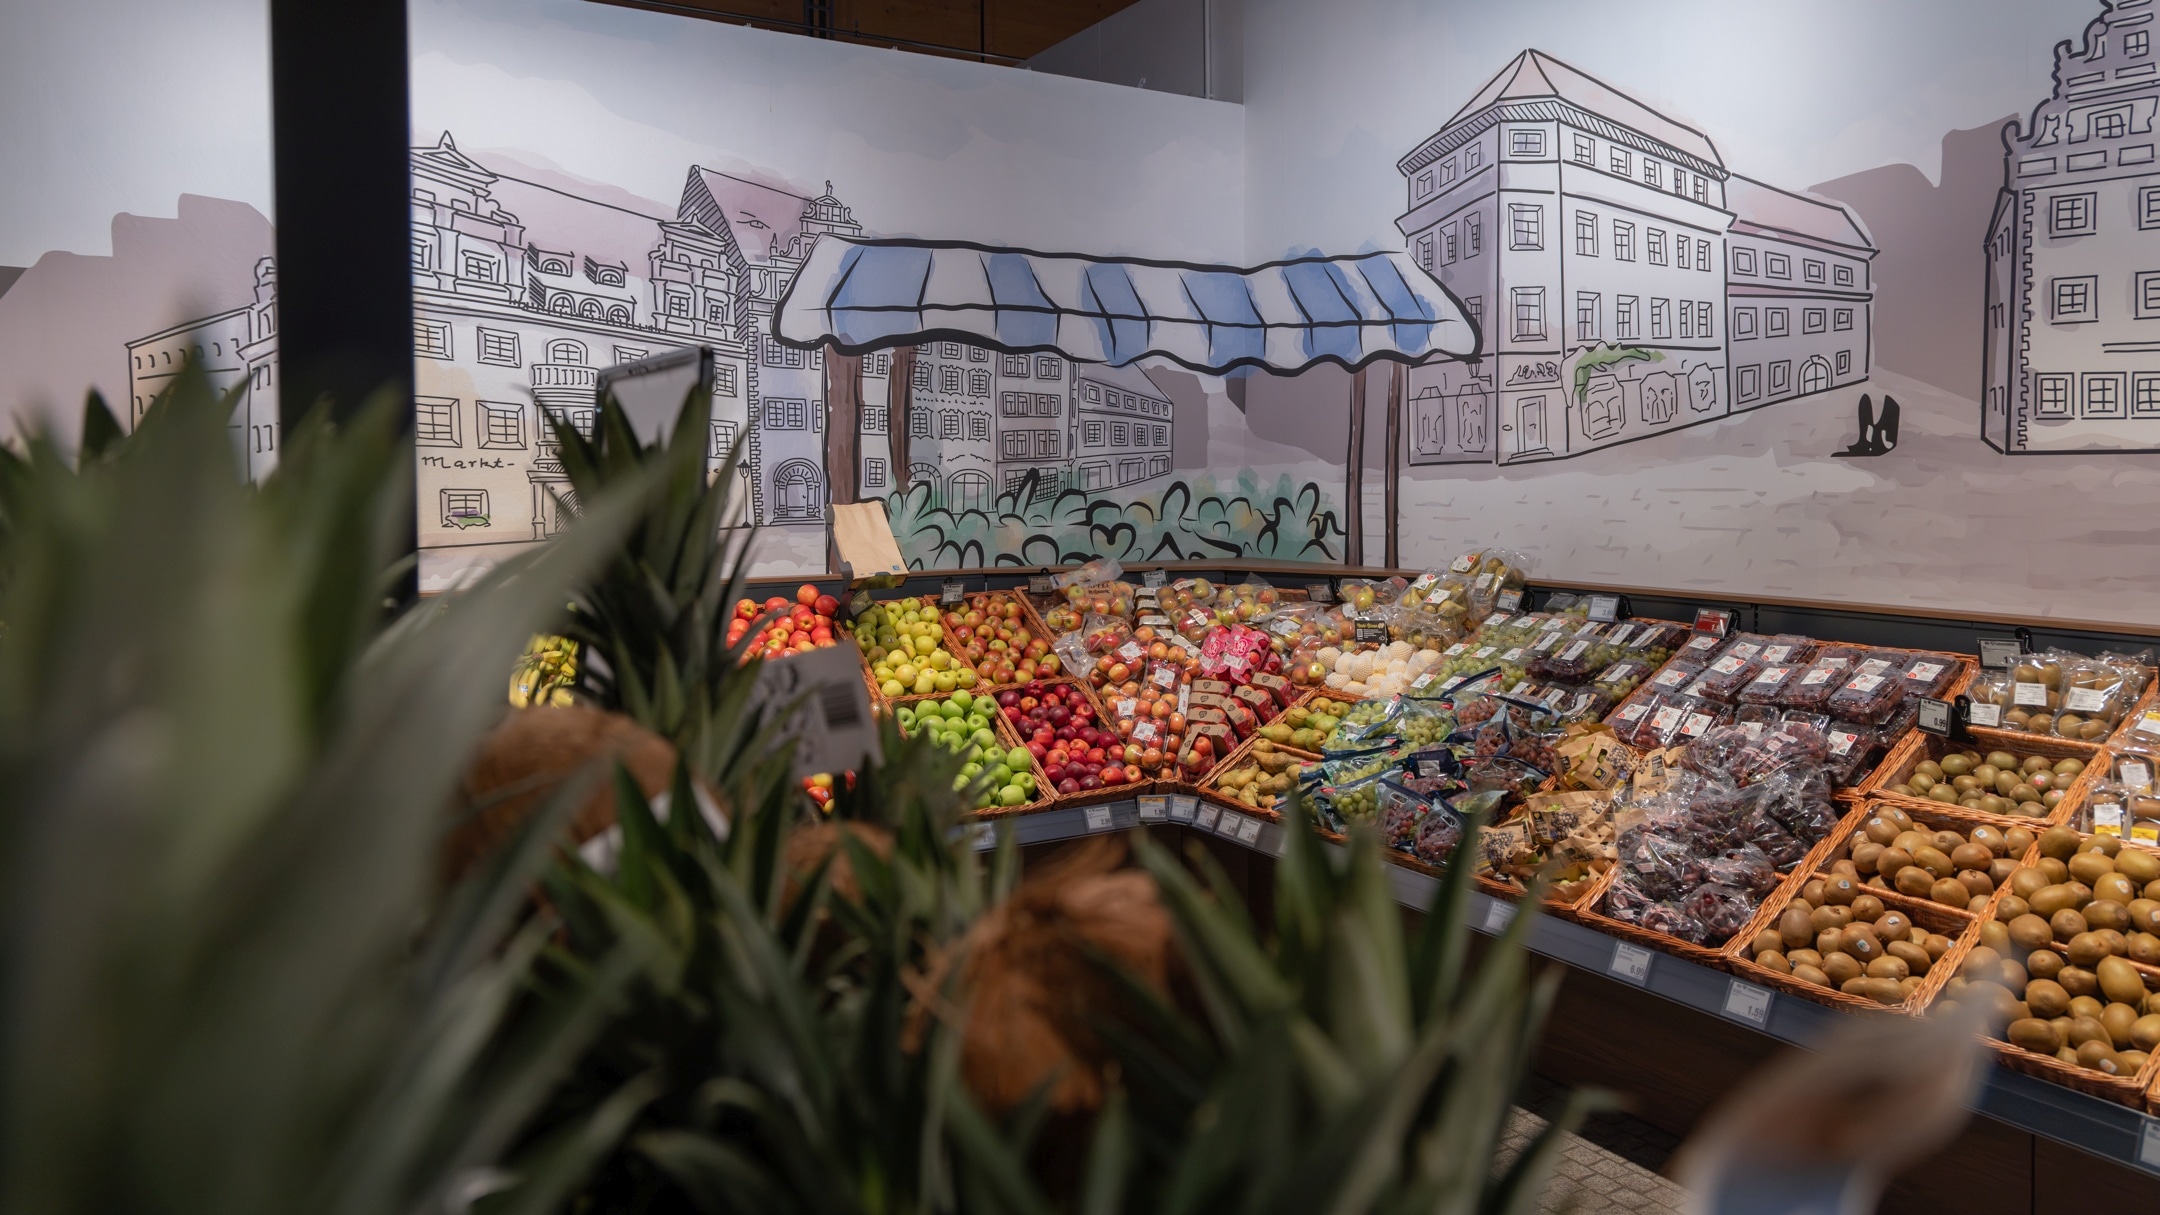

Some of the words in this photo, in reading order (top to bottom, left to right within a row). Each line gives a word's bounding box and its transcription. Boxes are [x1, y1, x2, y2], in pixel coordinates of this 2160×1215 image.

[421, 456, 515, 469] Markt-
[1934, 717, 1946, 728] 0.99
[1630, 964, 1646, 977] 6.99
[1747, 1005, 1764, 1019] 1.59
